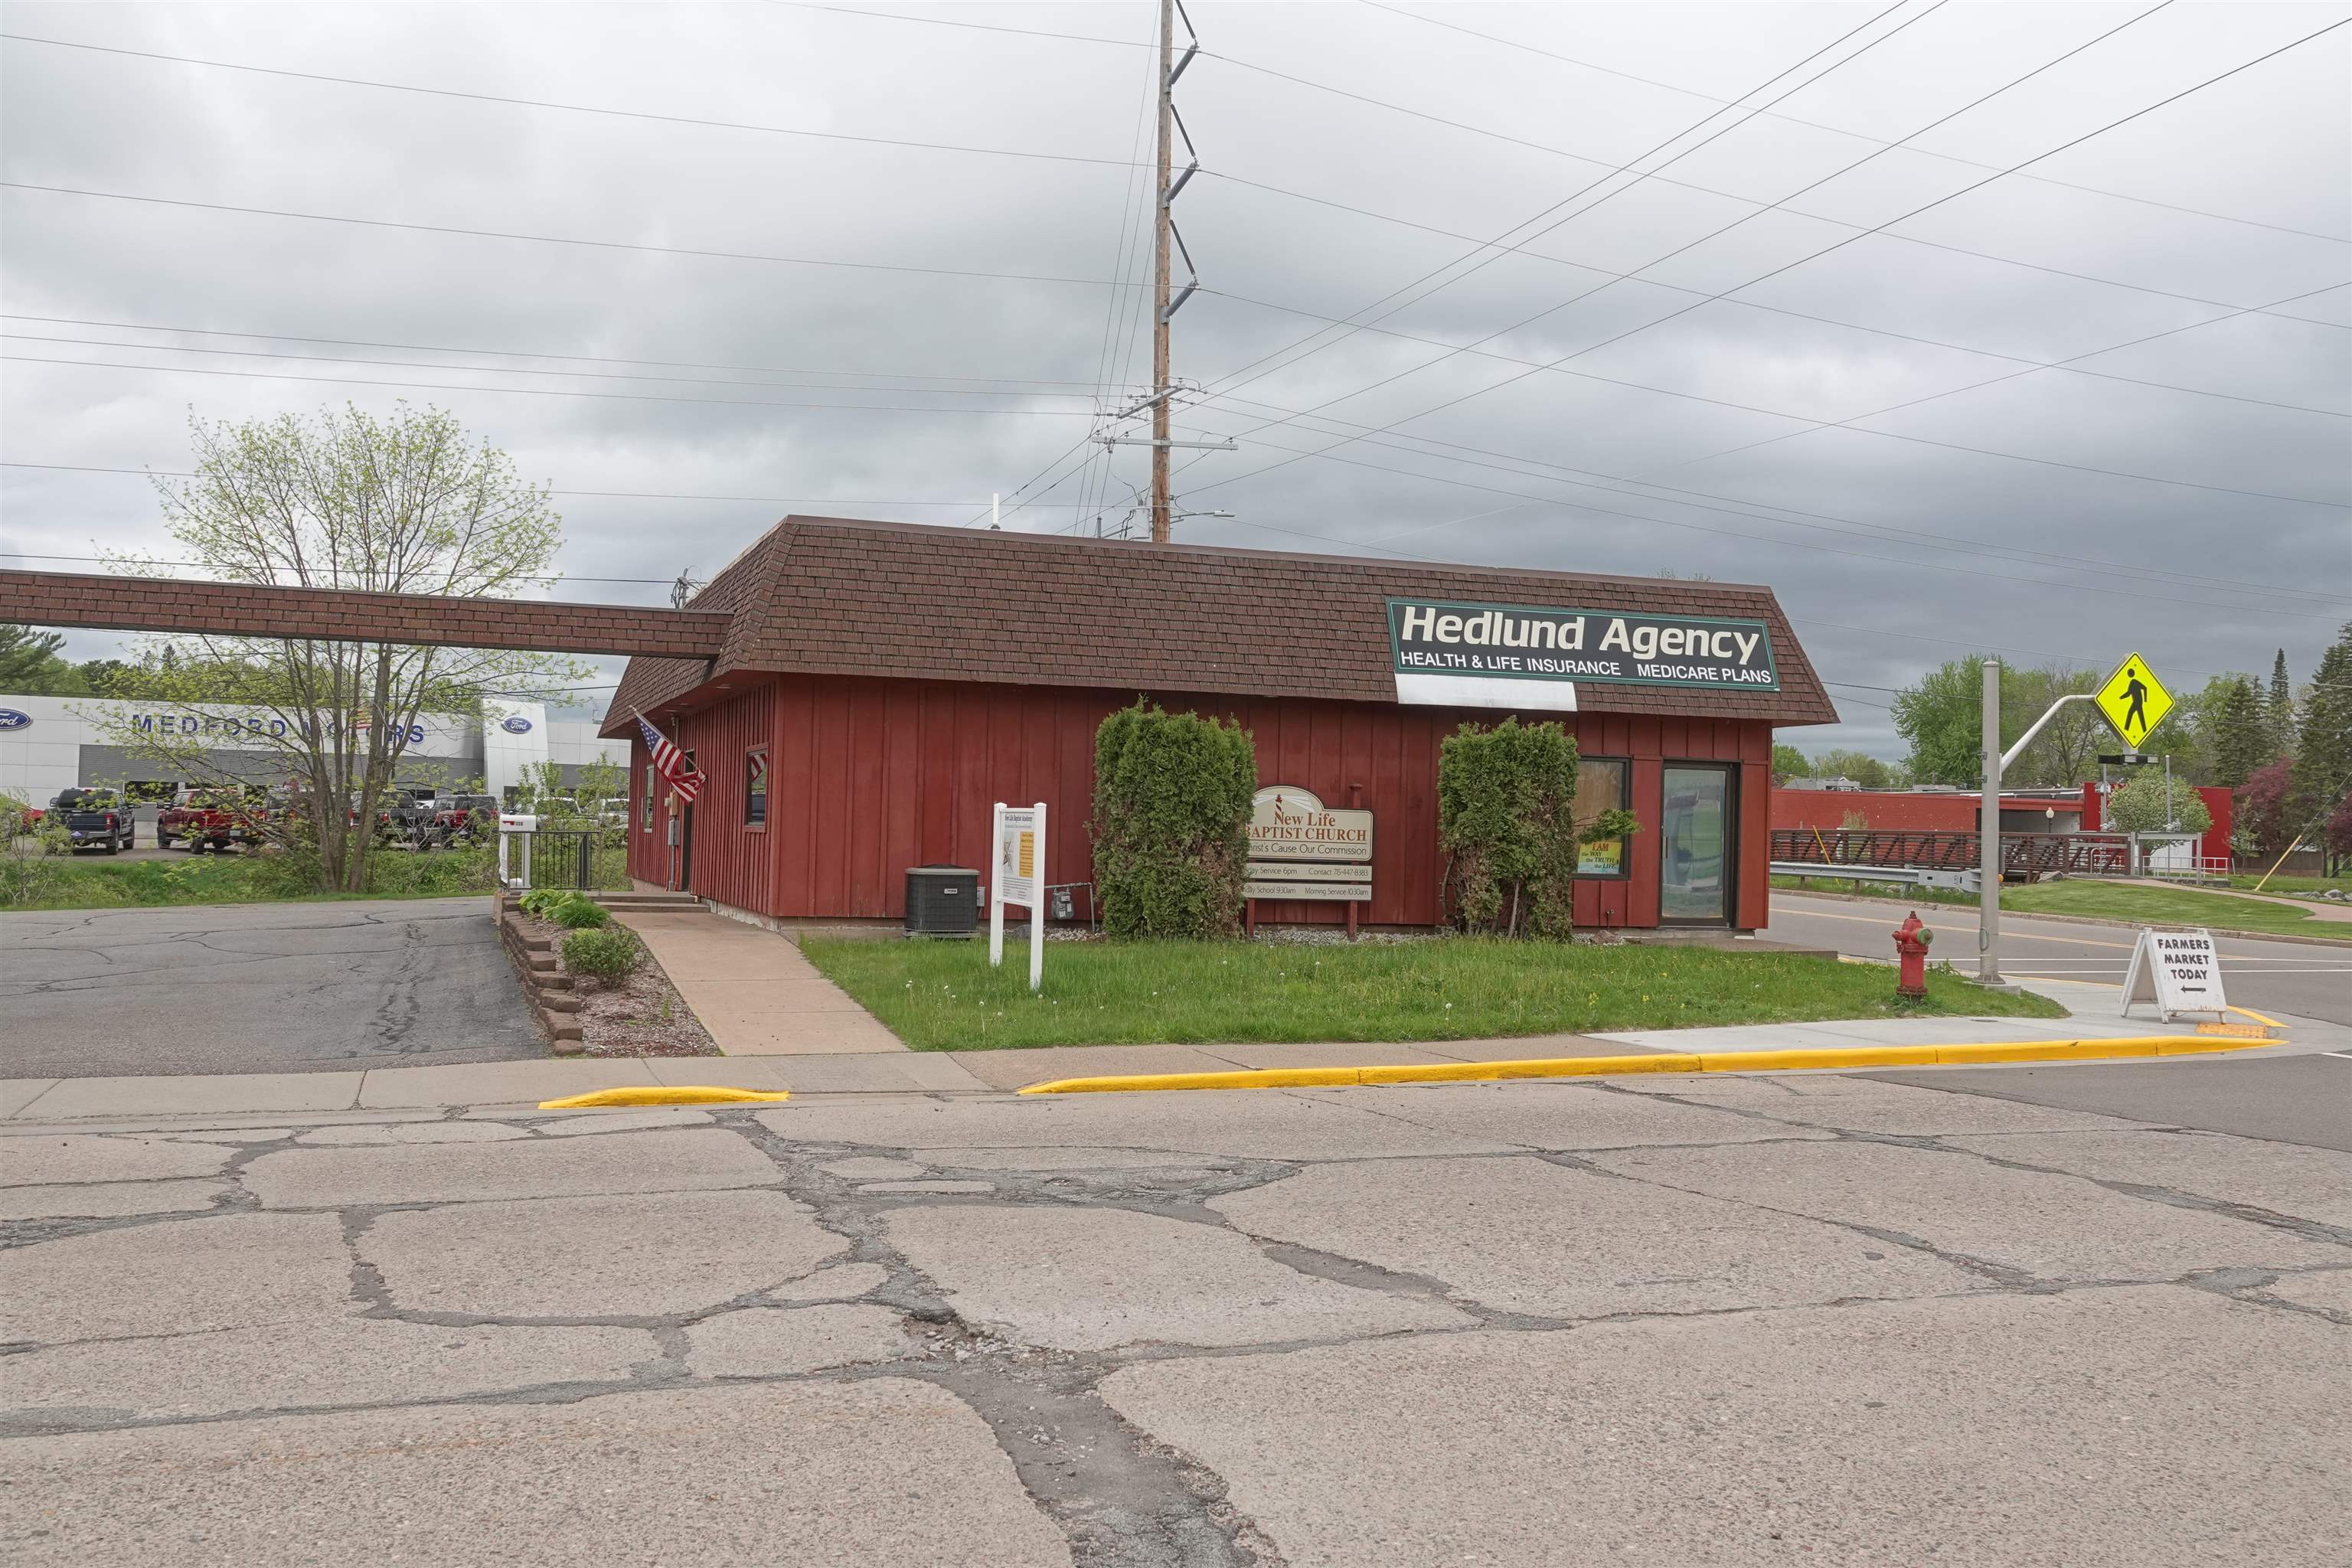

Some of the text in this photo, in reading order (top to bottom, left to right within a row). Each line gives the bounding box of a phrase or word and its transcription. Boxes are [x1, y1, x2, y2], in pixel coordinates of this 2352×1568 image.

[1402, 606, 1759, 665] Hedlund Agency
[1400, 651, 1772, 684] HEALTH & LIFE INSURANCE MEDICARE PLANS
[1274, 811, 1335, 826] New Life
[1305, 828, 1366, 841] CHURCH
[1272, 843, 1297, 853] Cause
[1299, 844, 1315, 853] Our
[1318, 844, 1367, 854] Commission
[1308, 867, 1331, 876] Contact
[1305, 887, 1326, 897] Morning
[2158, 939, 2210, 950] FARMERS
[2164, 954, 2210, 965] MARKET
[2171, 969, 2207, 980] TODAY
